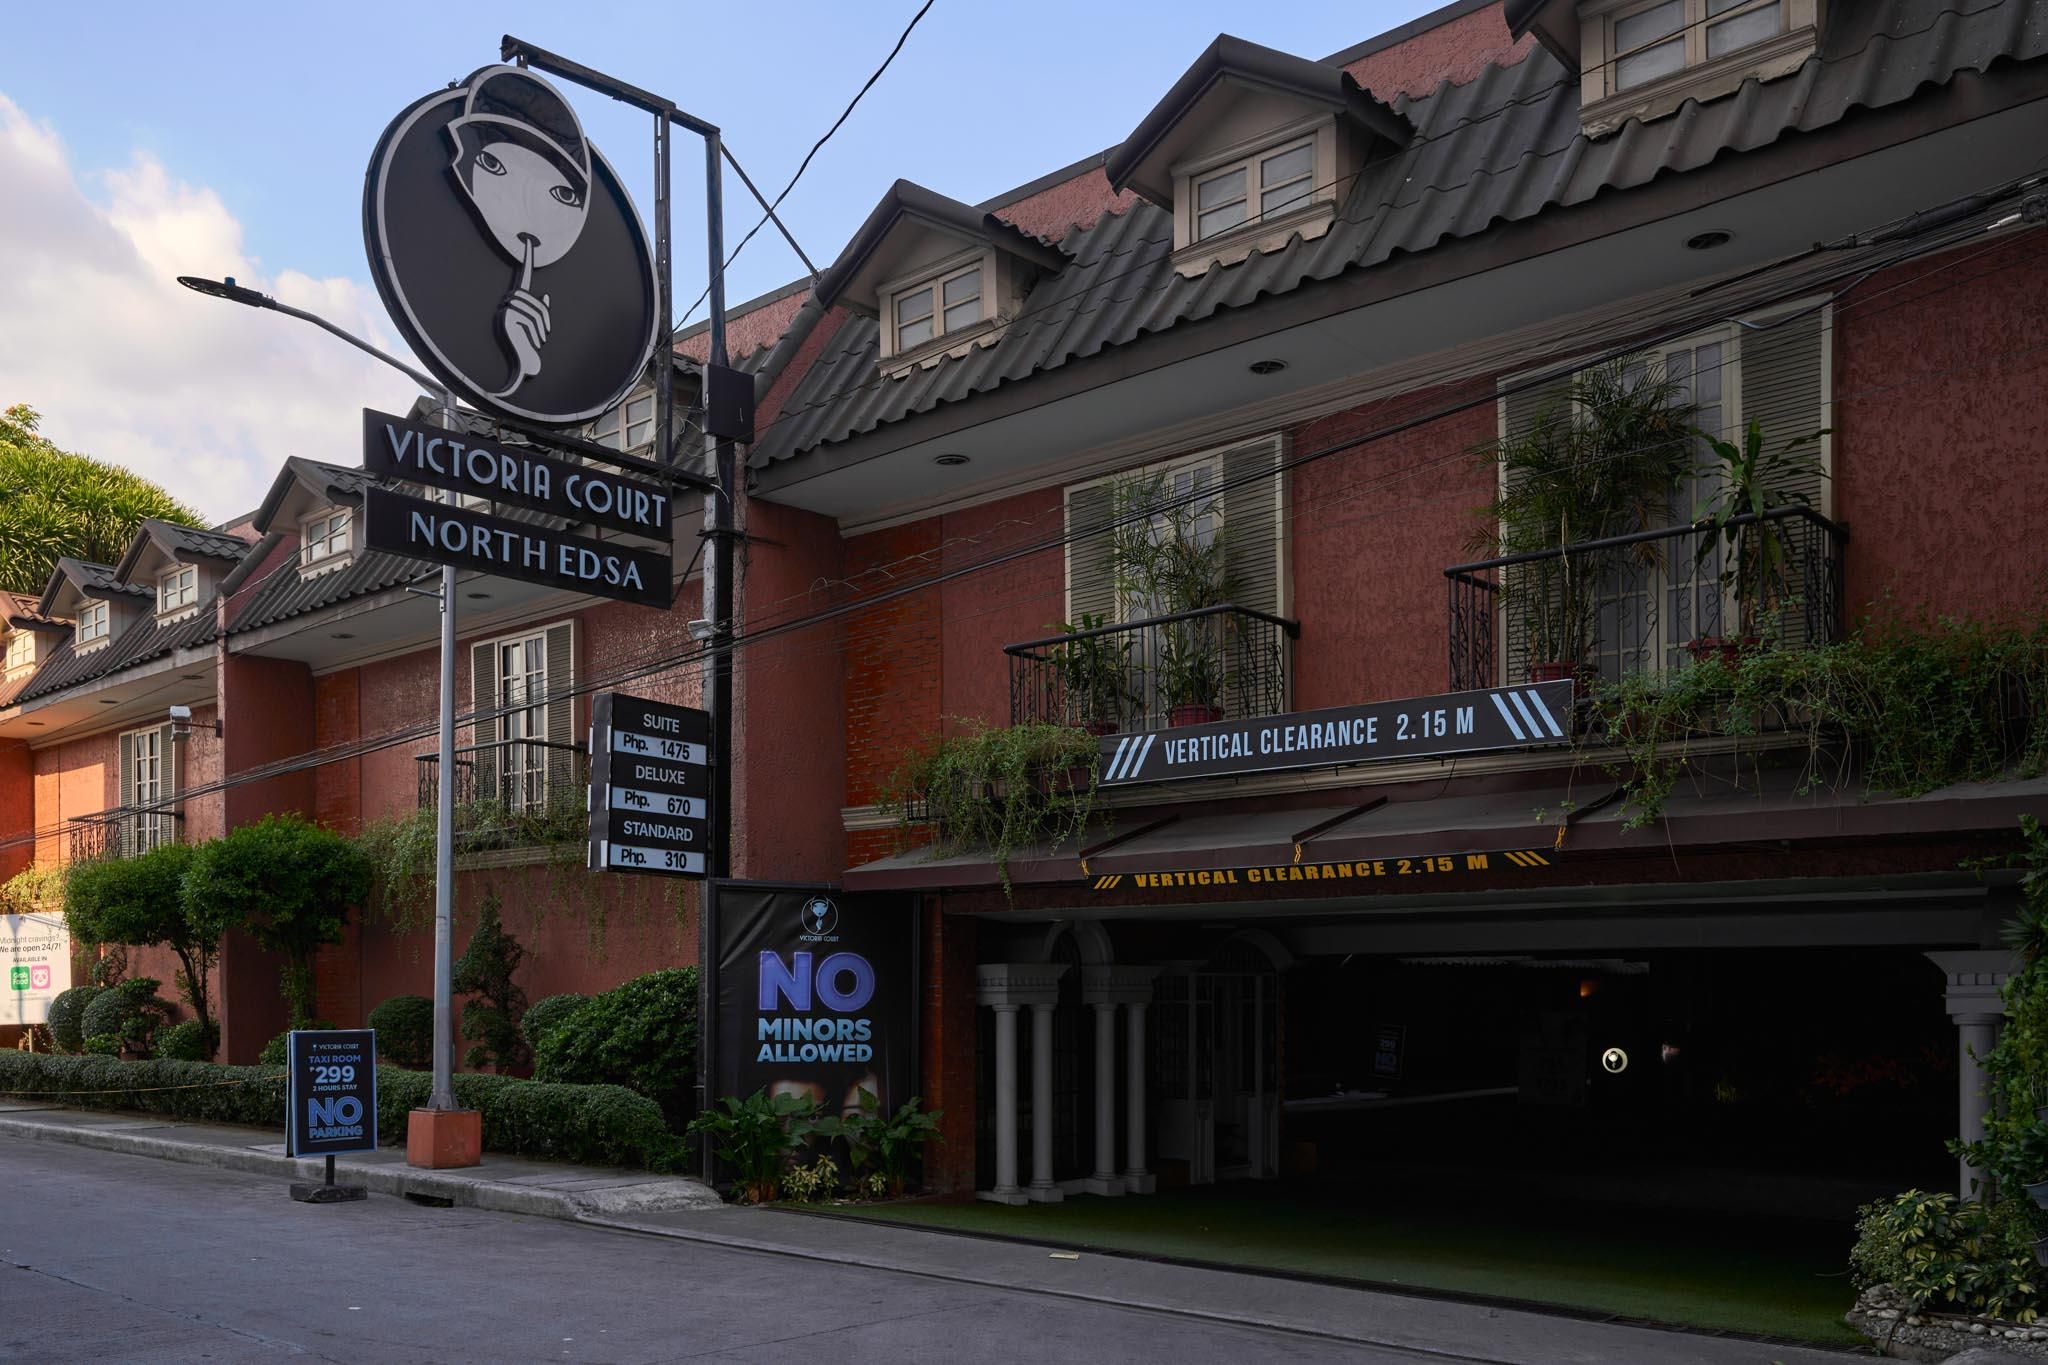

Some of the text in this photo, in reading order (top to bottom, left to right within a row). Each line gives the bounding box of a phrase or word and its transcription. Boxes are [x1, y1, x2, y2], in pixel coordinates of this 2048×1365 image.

[384, 423, 667, 527] VICTORIA COURT
[410, 511, 644, 591] NORTH EDSA
[643, 713, 680, 733] SUITE
[623, 733, 690, 760] Php. 1475
[1164, 706, 1475, 765] VERTICAL CLEARANCE 2.15 M
[635, 765, 685, 785] DELUXE
[624, 791, 691, 816] Php. 670
[623, 820, 693, 842] STANDARD
[620, 848, 687, 869] Php. 310
[1134, 854, 1488, 888] VERTICAL CLEARANCE 2.15 M
[10, 945, 22, 953] are
[22, 944, 41, 952] open
[41, 942, 61, 951] 24/7!
[759, 950, 875, 1012] NO
[757, 1018, 872, 1042] MINORS
[308, 1054, 361, 1064] TAXI ROOM
[757, 1043, 873, 1062] ALLOWED
[317, 1084, 341, 1092] HOURS
[308, 1095, 364, 1128] NO
[309, 1125, 363, 1139] PARKING
